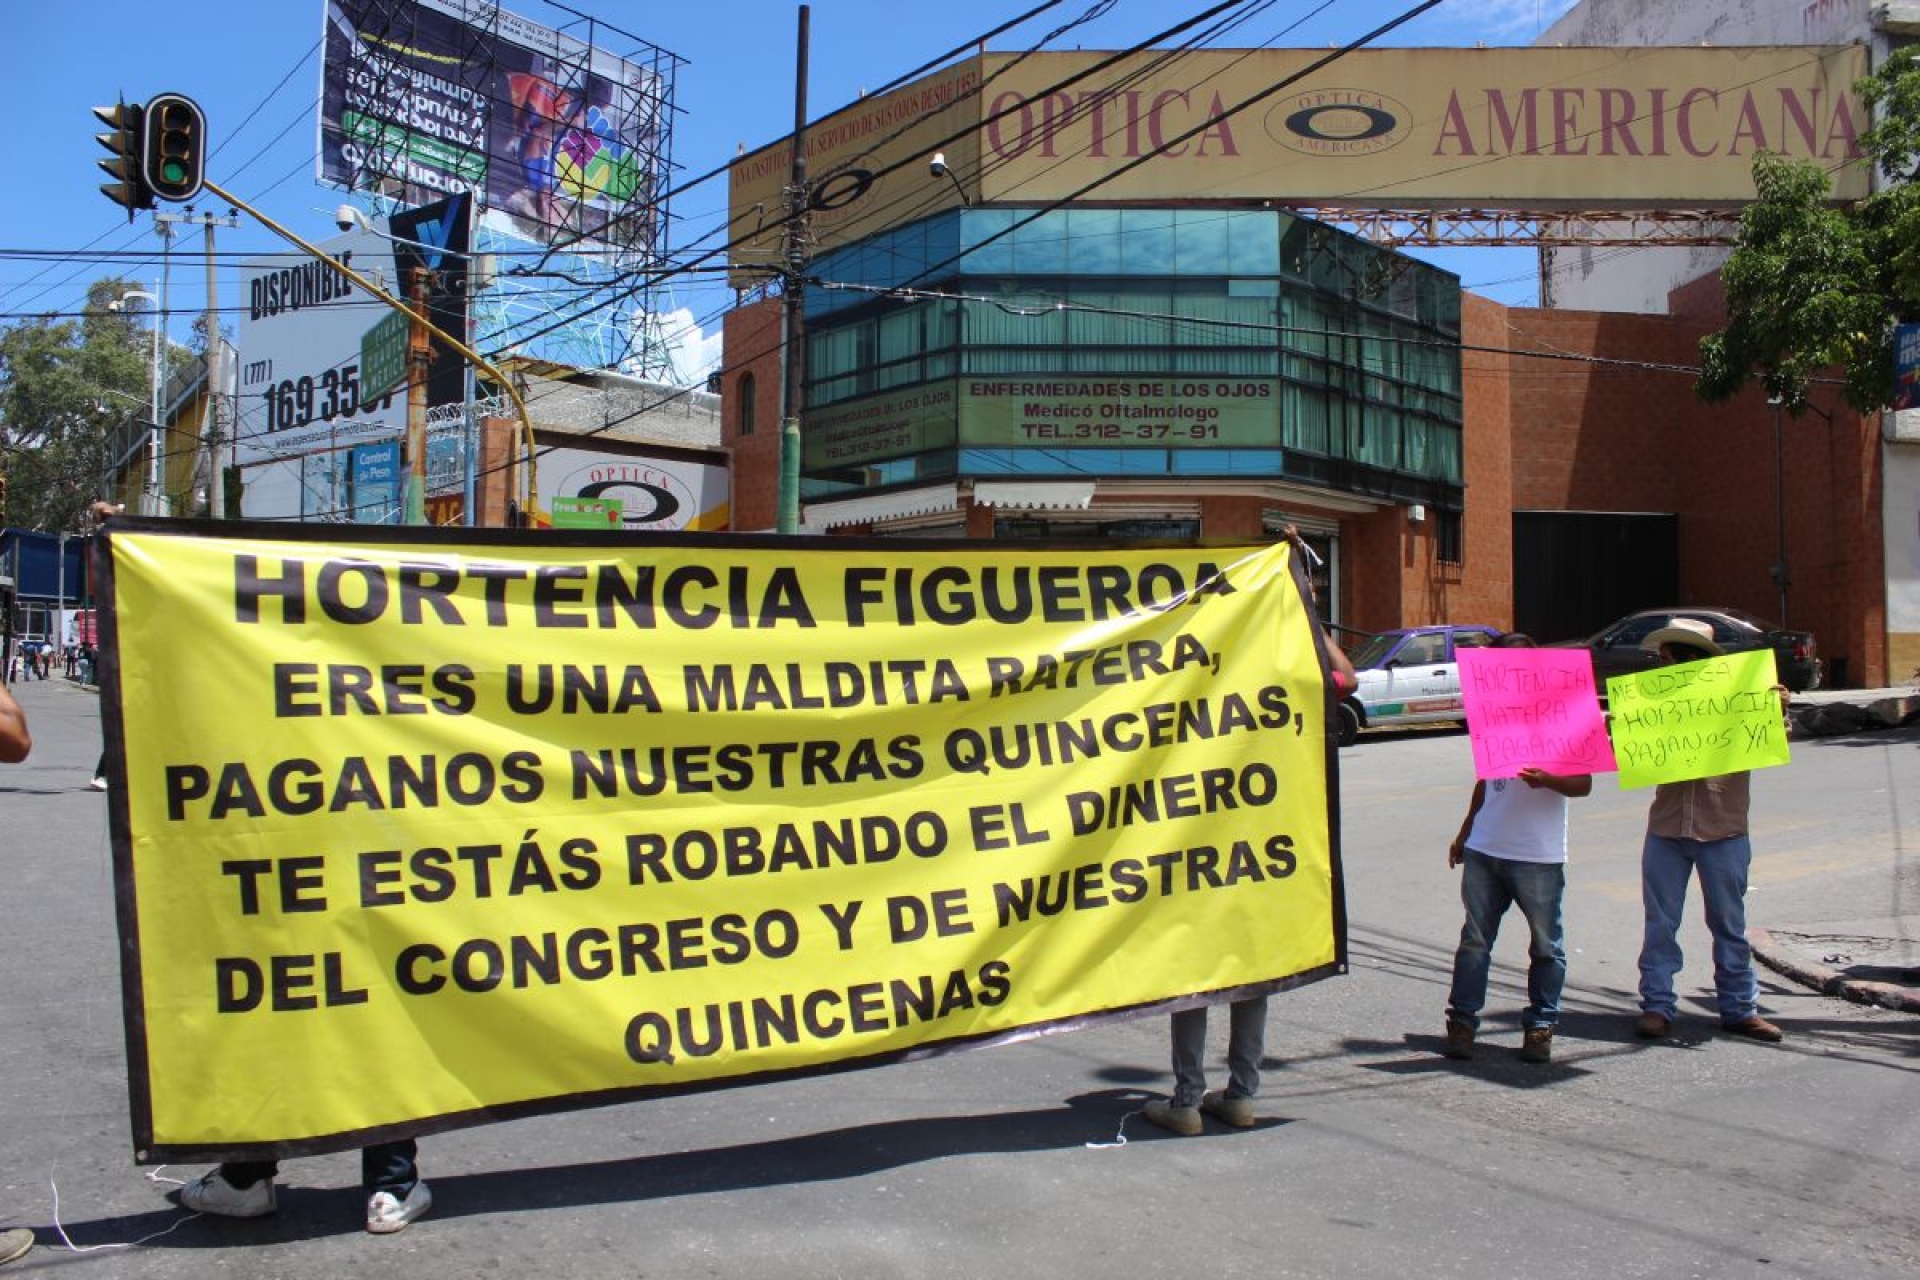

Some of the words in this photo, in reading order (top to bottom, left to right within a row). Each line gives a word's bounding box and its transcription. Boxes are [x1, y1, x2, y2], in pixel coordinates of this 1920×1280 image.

[987, 89, 1240, 158] OPTICA
[1298, 92, 1383, 110] OPTICA
[1433, 86, 1866, 158] AMERICANA
[250, 250, 352, 321] DISPONIBLE
[263, 375, 314, 433] 169
[970, 382, 1132, 399] ENFERMEDADES
[1138, 382, 1164, 398] DE
[1170, 382, 1210, 398] LOS
[1215, 382, 1271, 398] OJOS
[1099, 402, 1220, 423] Oftalmologo
[359, 448, 392, 465] Control
[370, 466, 391, 480] Peso
[590, 466, 668, 489] OPTICA
[234, 554, 817, 629] HORTENCIA
[843, 562, 1236, 627] FIGUEROA
[274, 663, 477, 717] ERES
[506, 664, 662, 715] UNA
[684, 660, 974, 713] MALDITA
[988, 632, 1221, 696] RATERA,
[1469, 659, 1589, 695] HORTENCIA
[1479, 699, 1570, 729] RATERA
[1623, 690, 1777, 734] HORTENCIA
[165, 750, 544, 821] PAGANOS
[571, 733, 925, 799] NUESTRAS
[944, 684, 1304, 775] QUINCENAS,
[221, 855, 327, 915] TE
[358, 829, 601, 908] ESTÁS
[626, 810, 949, 886] ROBANDO
[969, 802, 1049, 851] EL
[1070, 762, 1279, 837] DINERO
[215, 951, 369, 1014] DEL
[394, 908, 800, 996] CONGRESO
[820, 900, 864, 950] Y
[888, 889, 974, 943] DE
[993, 833, 1298, 929] NUESTRAS
[624, 960, 1012, 1065] QUINCENAS
